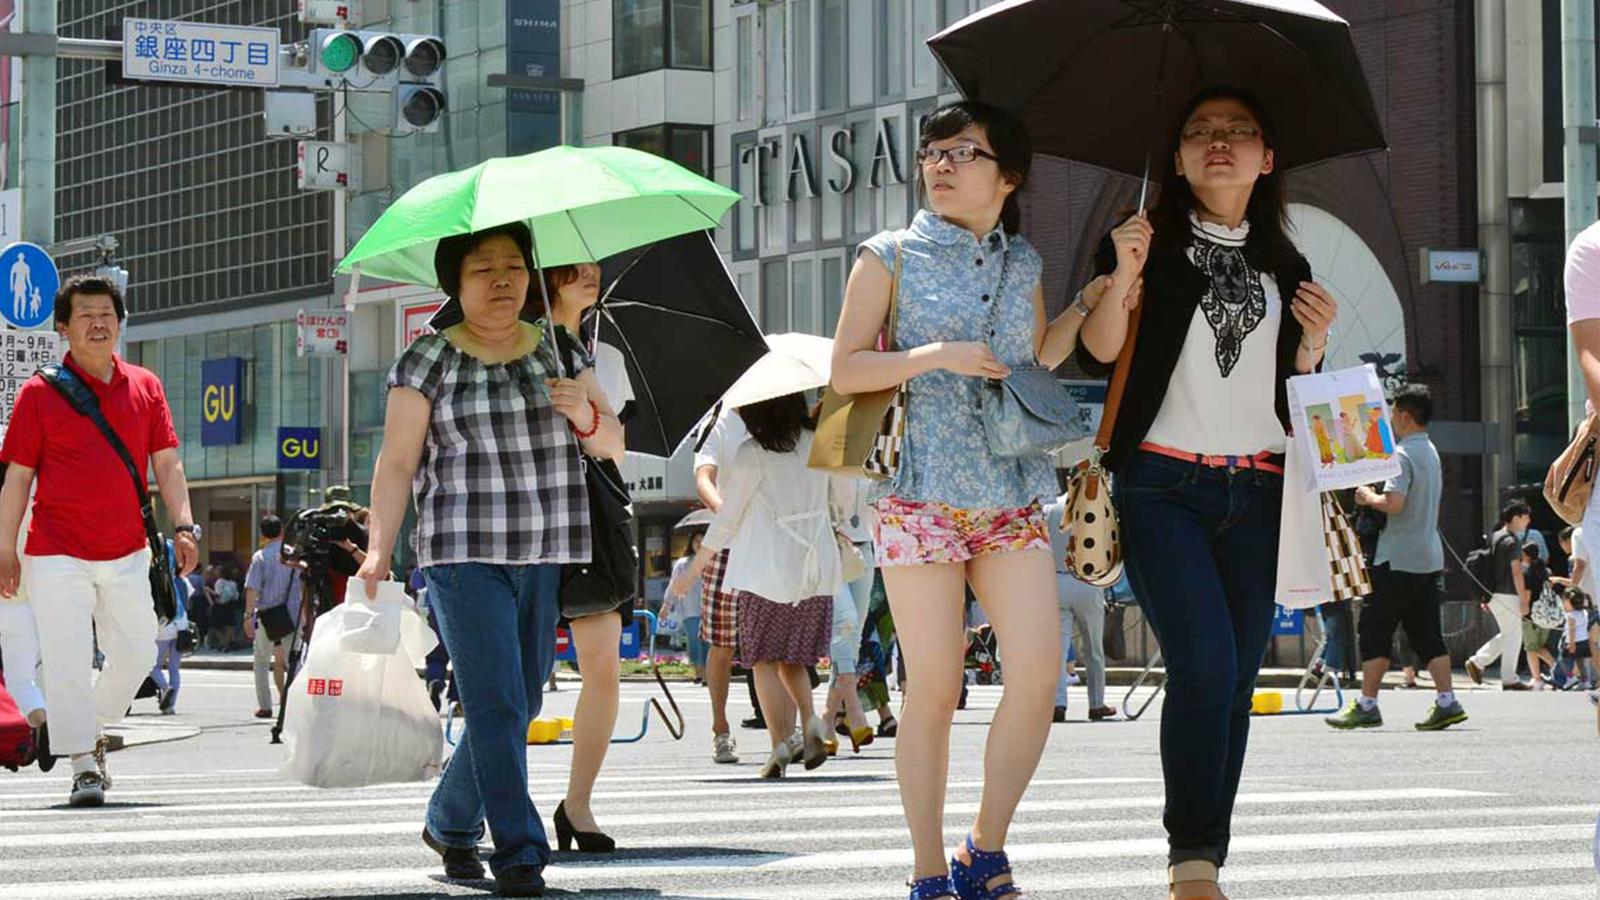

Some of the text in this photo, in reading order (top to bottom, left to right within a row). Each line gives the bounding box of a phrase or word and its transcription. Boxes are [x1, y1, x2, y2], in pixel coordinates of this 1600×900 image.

[135, 21, 177, 35] 中央区
[135, 34, 268, 66] 銀座四丁目
[148, 60, 255, 80] Ginza 4-chome
[317, 146, 329, 173] R
[742, 118, 914, 208] TASA
[203, 384, 235, 423] GU
[282, 437, 319, 458] GU
